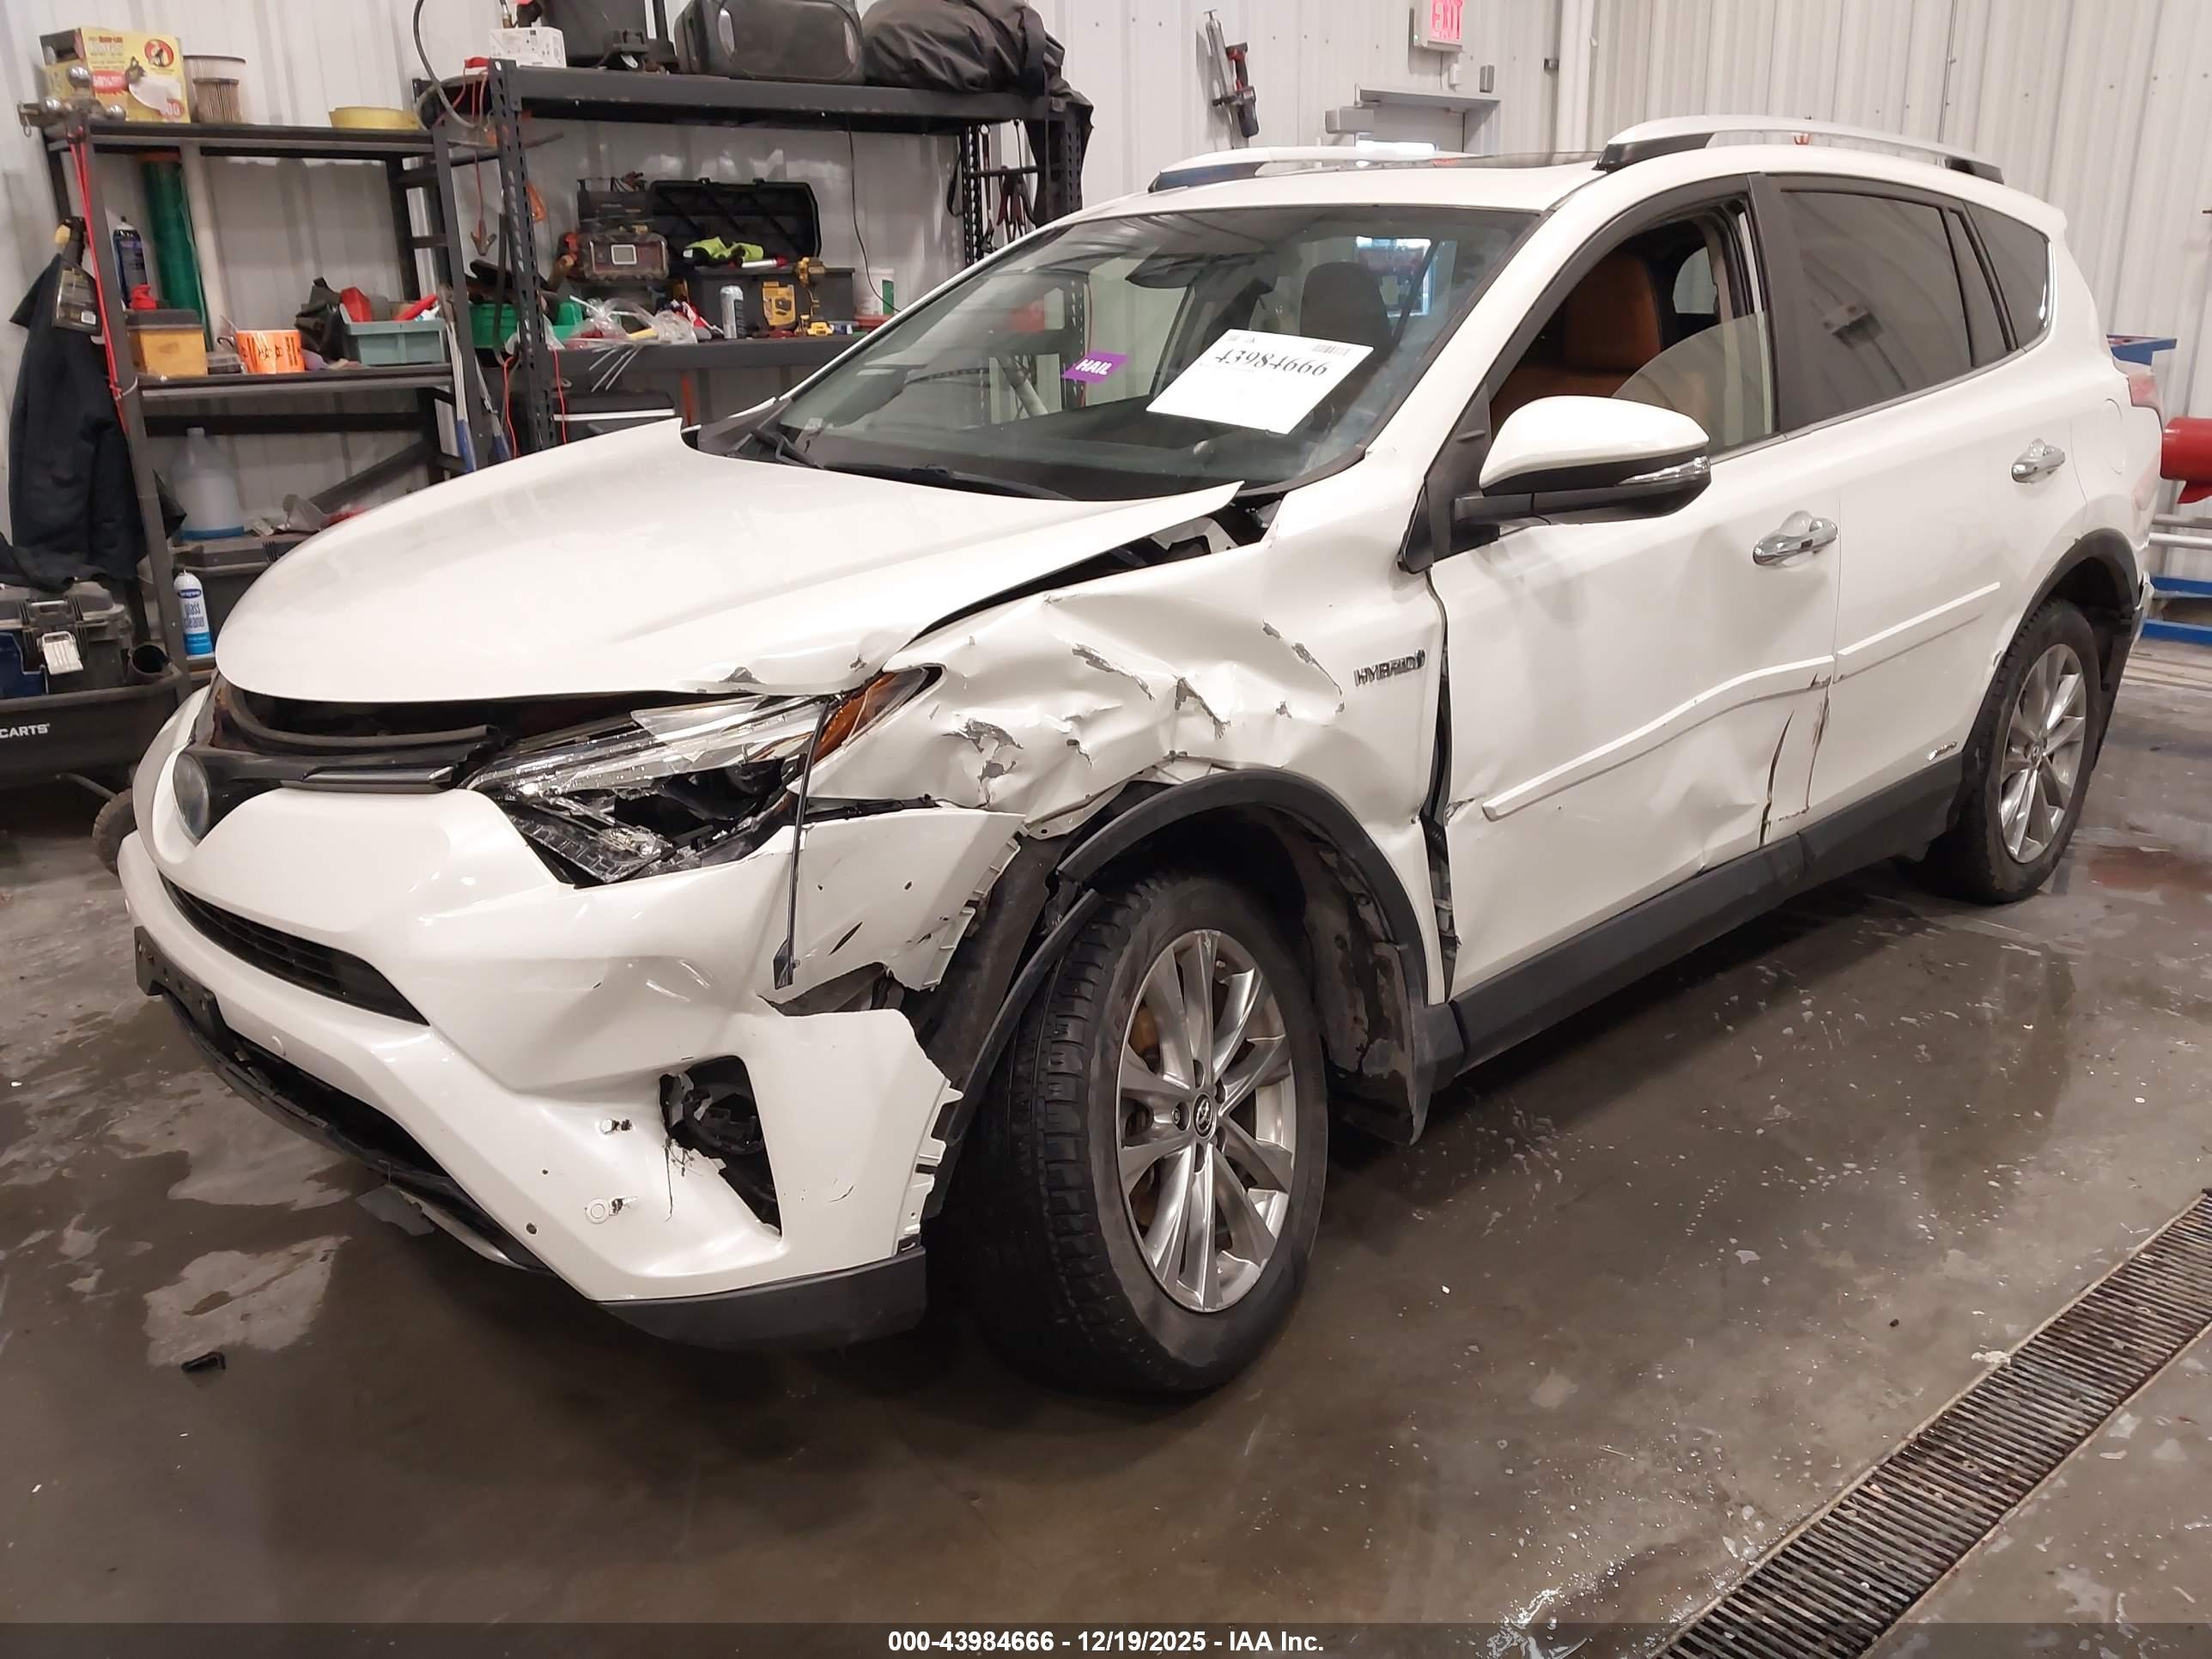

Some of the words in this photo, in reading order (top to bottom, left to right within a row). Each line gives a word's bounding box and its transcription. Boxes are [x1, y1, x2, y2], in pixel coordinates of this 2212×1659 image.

[1431, 0, 1462, 40] EXIT
[1075, 358, 1113, 375] HAIL
[1215, 349, 1331, 377] 43984666
[1353, 656, 1416, 686] HYBRID
[0, 723, 49, 738] CARTS
